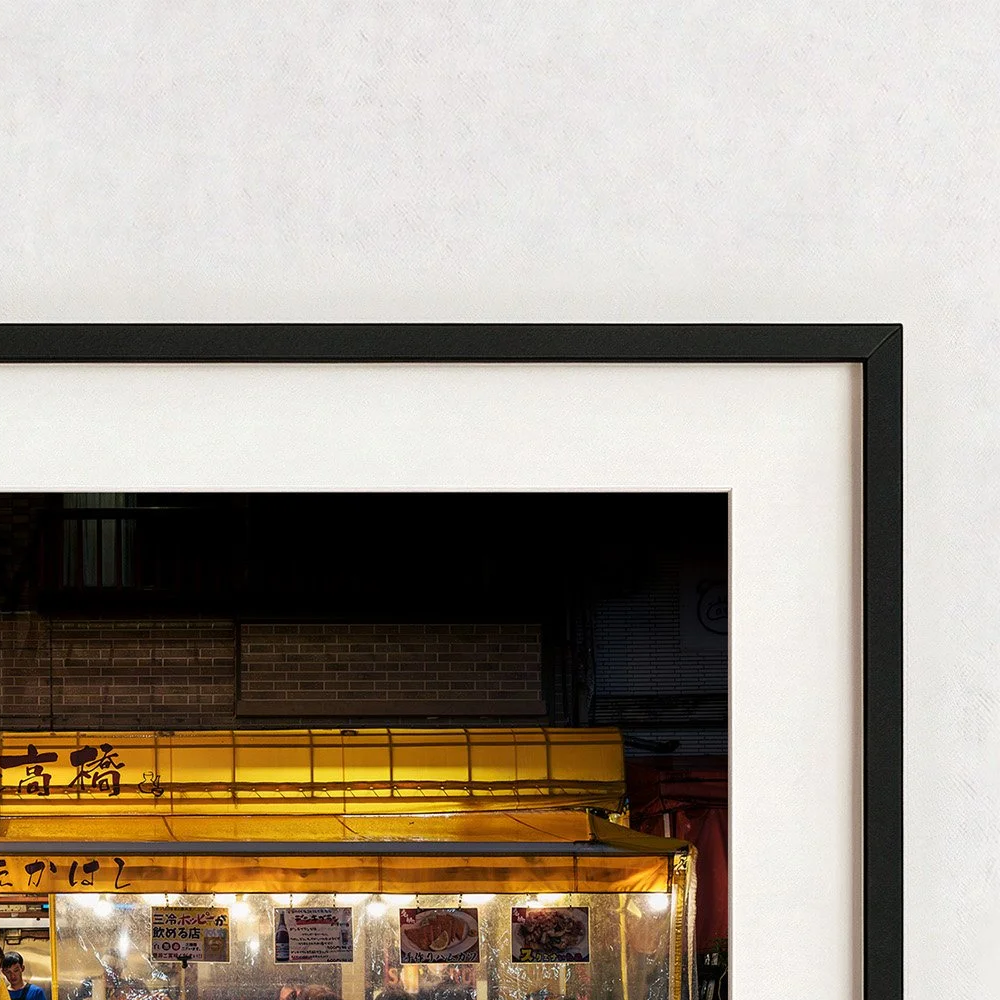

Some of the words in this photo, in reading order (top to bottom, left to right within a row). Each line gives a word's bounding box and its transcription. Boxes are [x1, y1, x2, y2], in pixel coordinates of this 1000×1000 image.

[152, 911, 227, 927] 三冷ホッピーが
[152, 926, 201, 939] 飲める店
